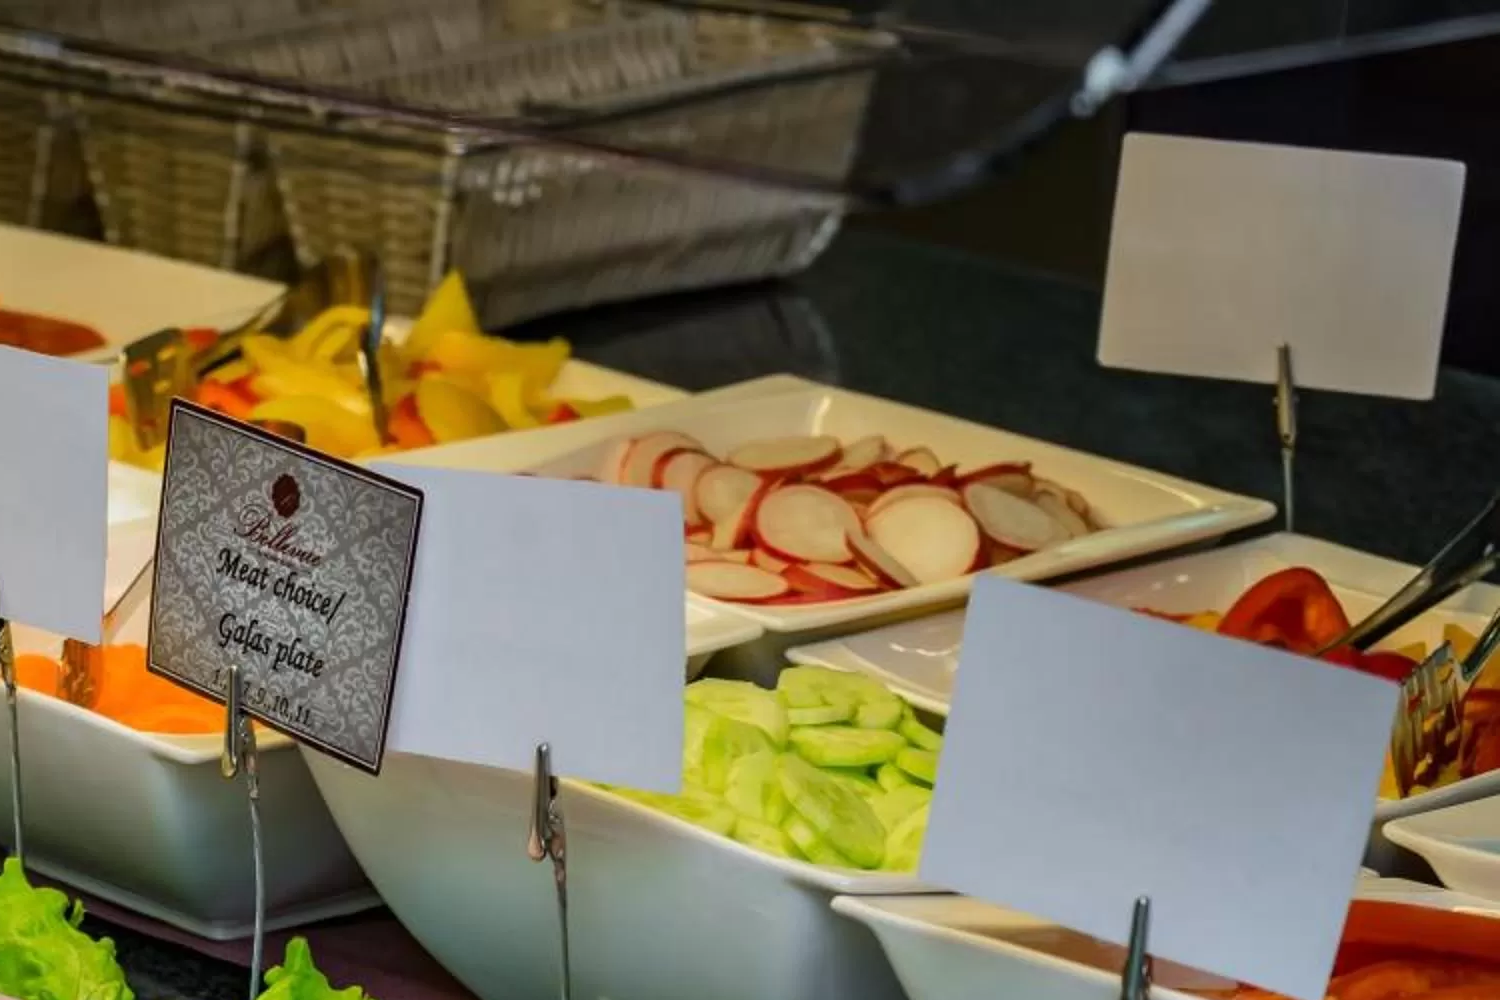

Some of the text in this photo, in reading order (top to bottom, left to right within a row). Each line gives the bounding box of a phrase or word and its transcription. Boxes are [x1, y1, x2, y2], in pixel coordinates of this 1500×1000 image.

[216, 547, 270, 590] Meat
[273, 571, 347, 625] choice/
[272, 637, 324, 678] plate
